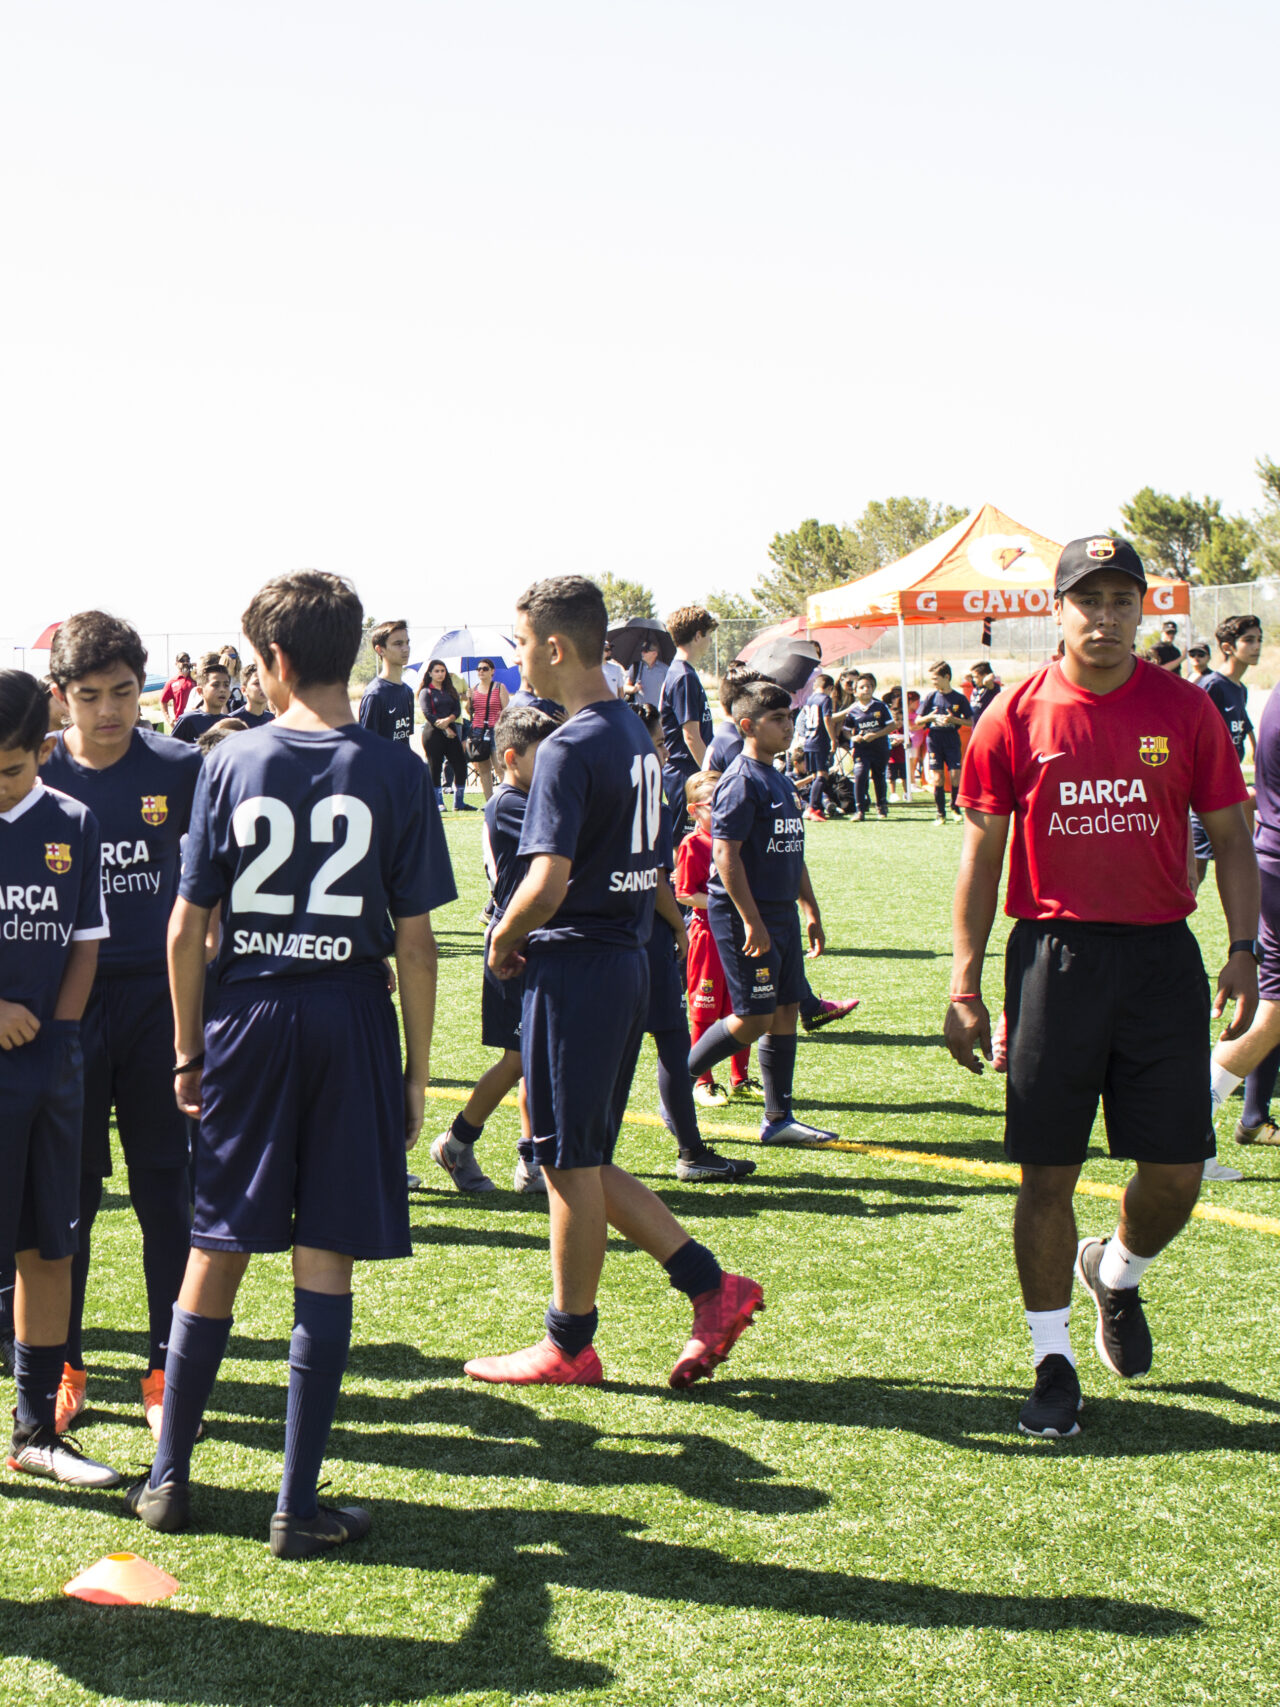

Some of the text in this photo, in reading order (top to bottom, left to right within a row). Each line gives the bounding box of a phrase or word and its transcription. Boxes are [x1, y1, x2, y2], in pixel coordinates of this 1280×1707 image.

[962, 589, 1056, 614] GATO
[629, 753, 661, 854] 10
[1059, 778, 1148, 808] BARÇA
[1047, 807, 1161, 837] Academy
[101, 840, 150, 869] RÇA
[231, 794, 373, 917] 22
[101, 868, 161, 895] demy
